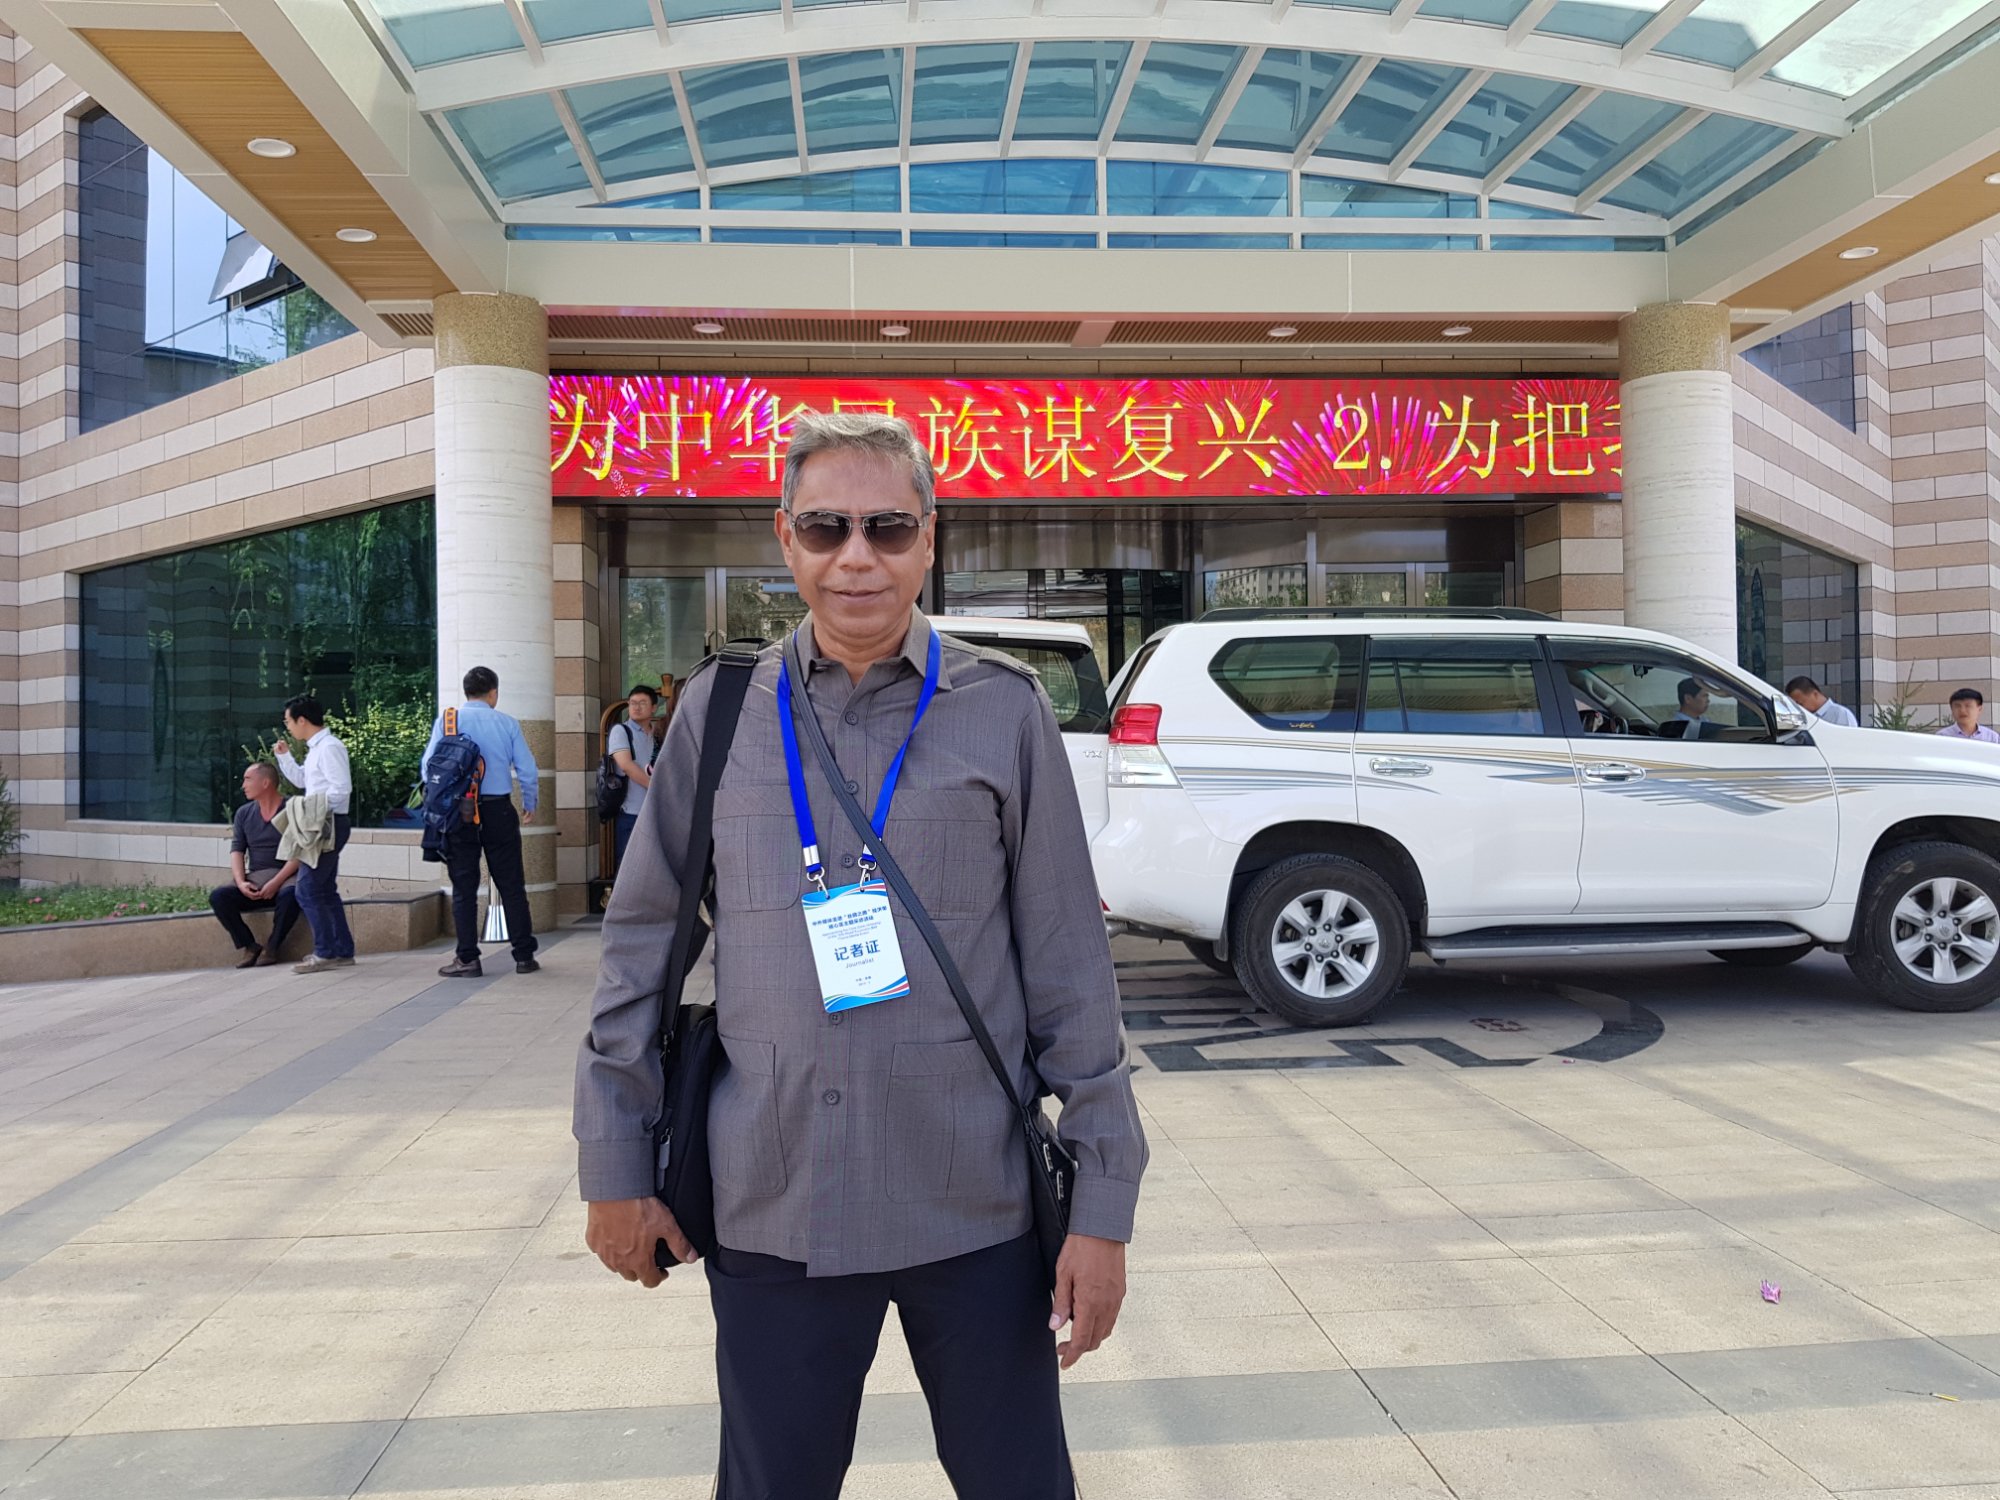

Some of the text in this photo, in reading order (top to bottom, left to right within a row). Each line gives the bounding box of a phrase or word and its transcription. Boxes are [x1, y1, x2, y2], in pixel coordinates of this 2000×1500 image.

[550, 394, 1279, 482] 为中华族谋复兴
[834, 940, 881, 961] 记者证
[846, 957, 874, 968] Journalist
